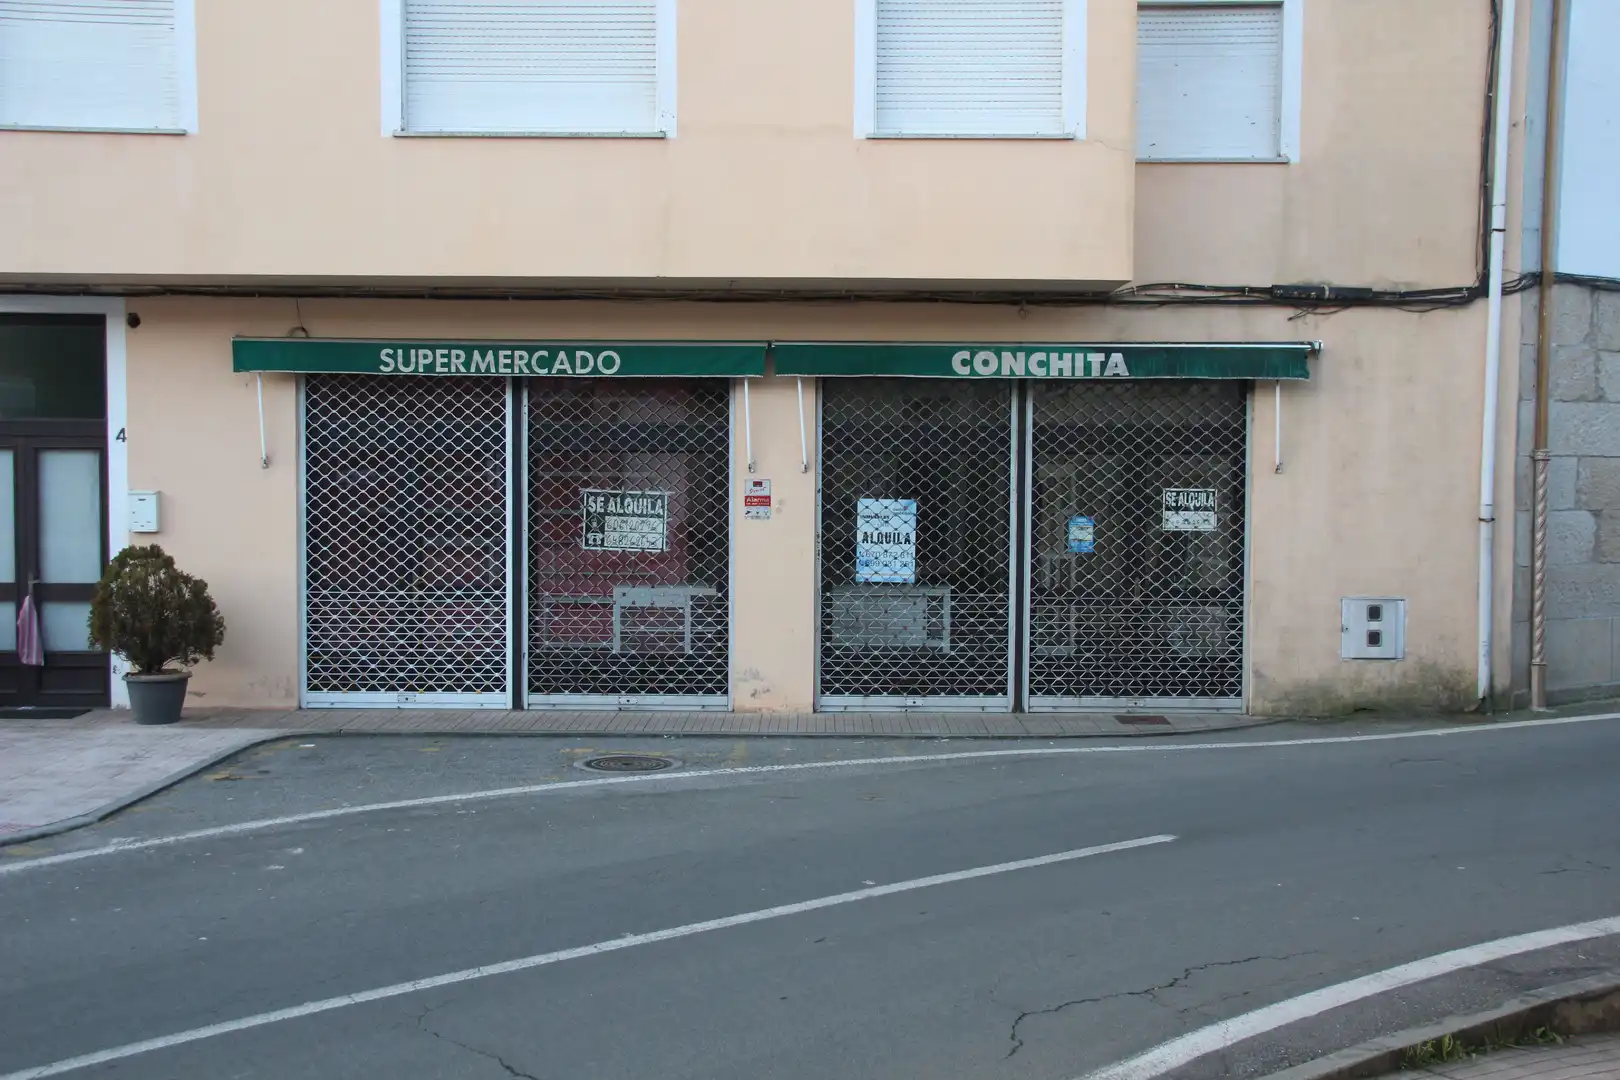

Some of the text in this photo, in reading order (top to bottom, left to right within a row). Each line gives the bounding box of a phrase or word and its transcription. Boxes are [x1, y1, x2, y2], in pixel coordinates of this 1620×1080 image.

[379, 348, 621, 374] SUPERMERCADO
[951, 350, 1129, 377] CONCHITA
[116, 428, 127, 443] 4
[588, 495, 664, 516] SE ALQUILA
[1165, 492, 1215, 510] SE ALQUILA
[861, 532, 911, 545] ALQUILA
